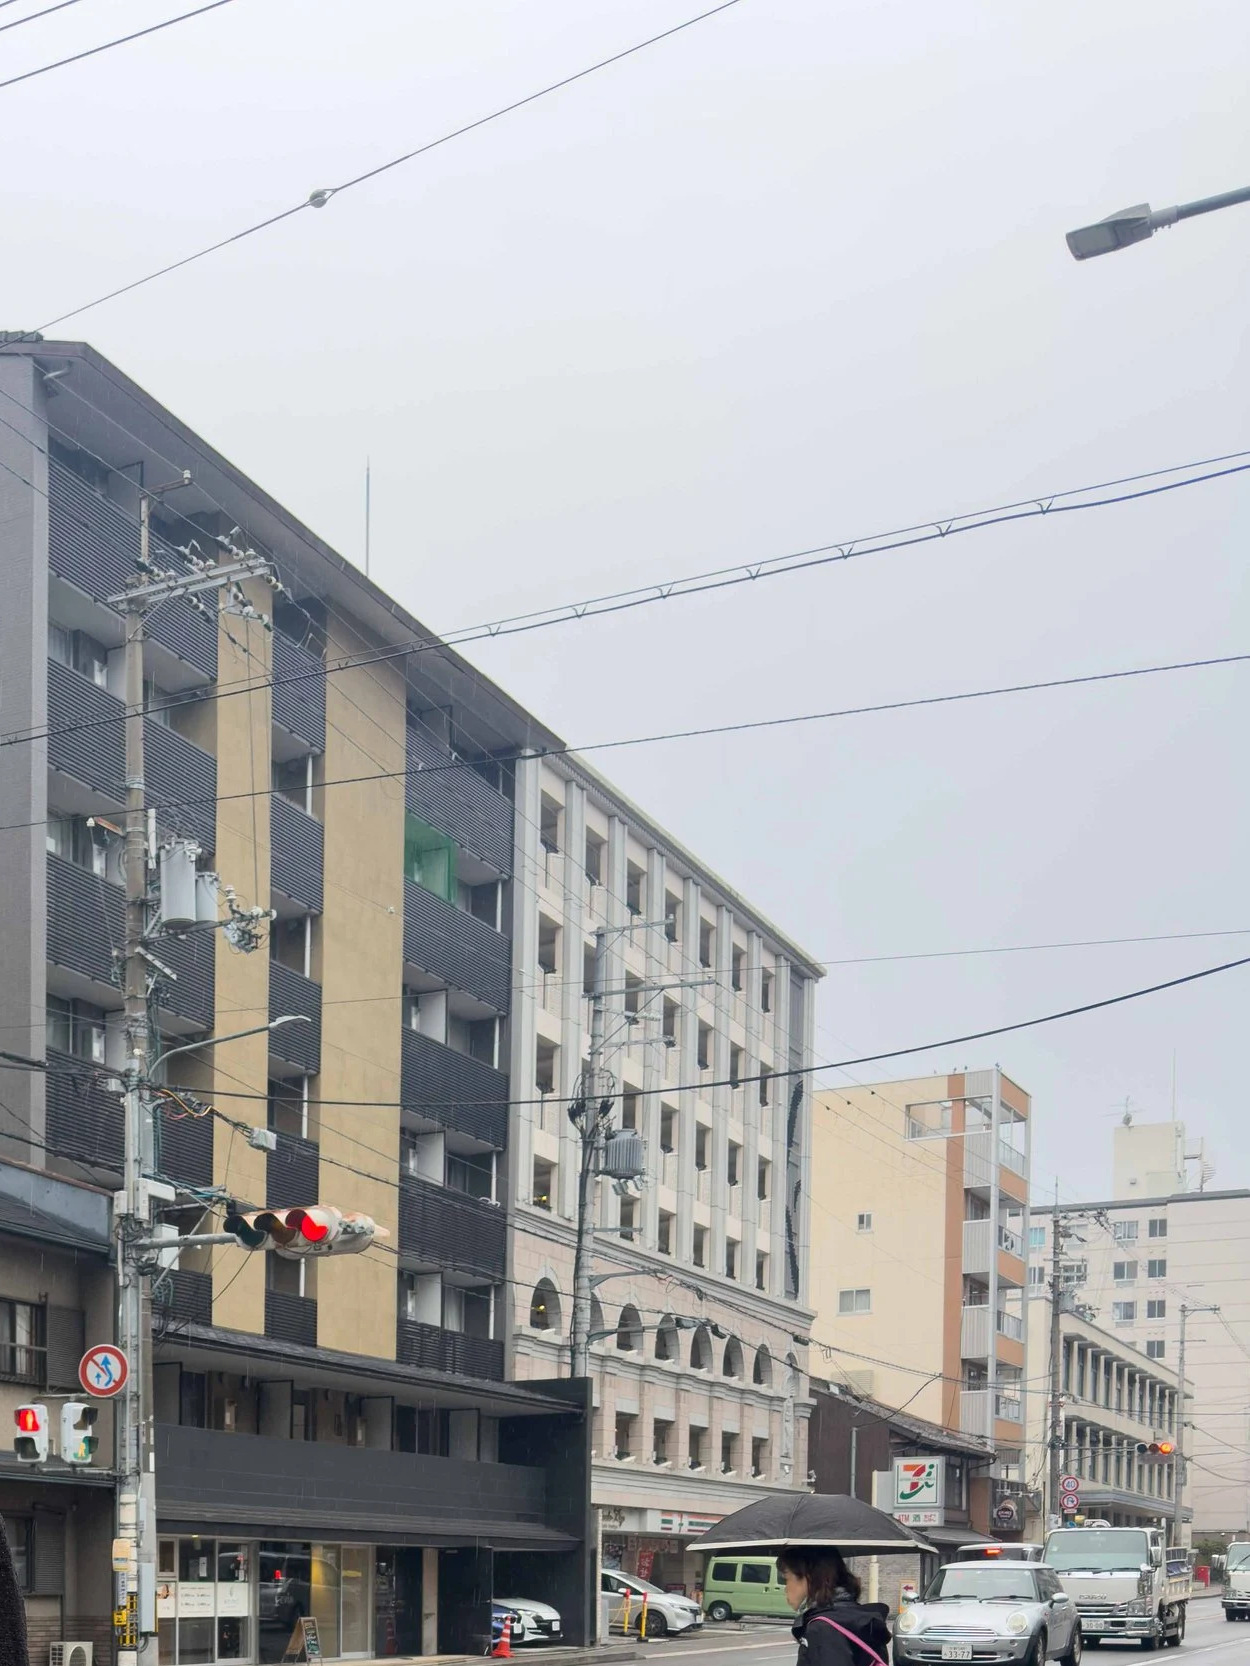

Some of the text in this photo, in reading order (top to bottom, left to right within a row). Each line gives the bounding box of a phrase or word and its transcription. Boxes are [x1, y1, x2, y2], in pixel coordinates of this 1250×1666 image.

[1065, 1481, 1076, 1489] 40
[898, 1514, 910, 1524] ATM
[948, 1650, 970, 1659] 33-77
